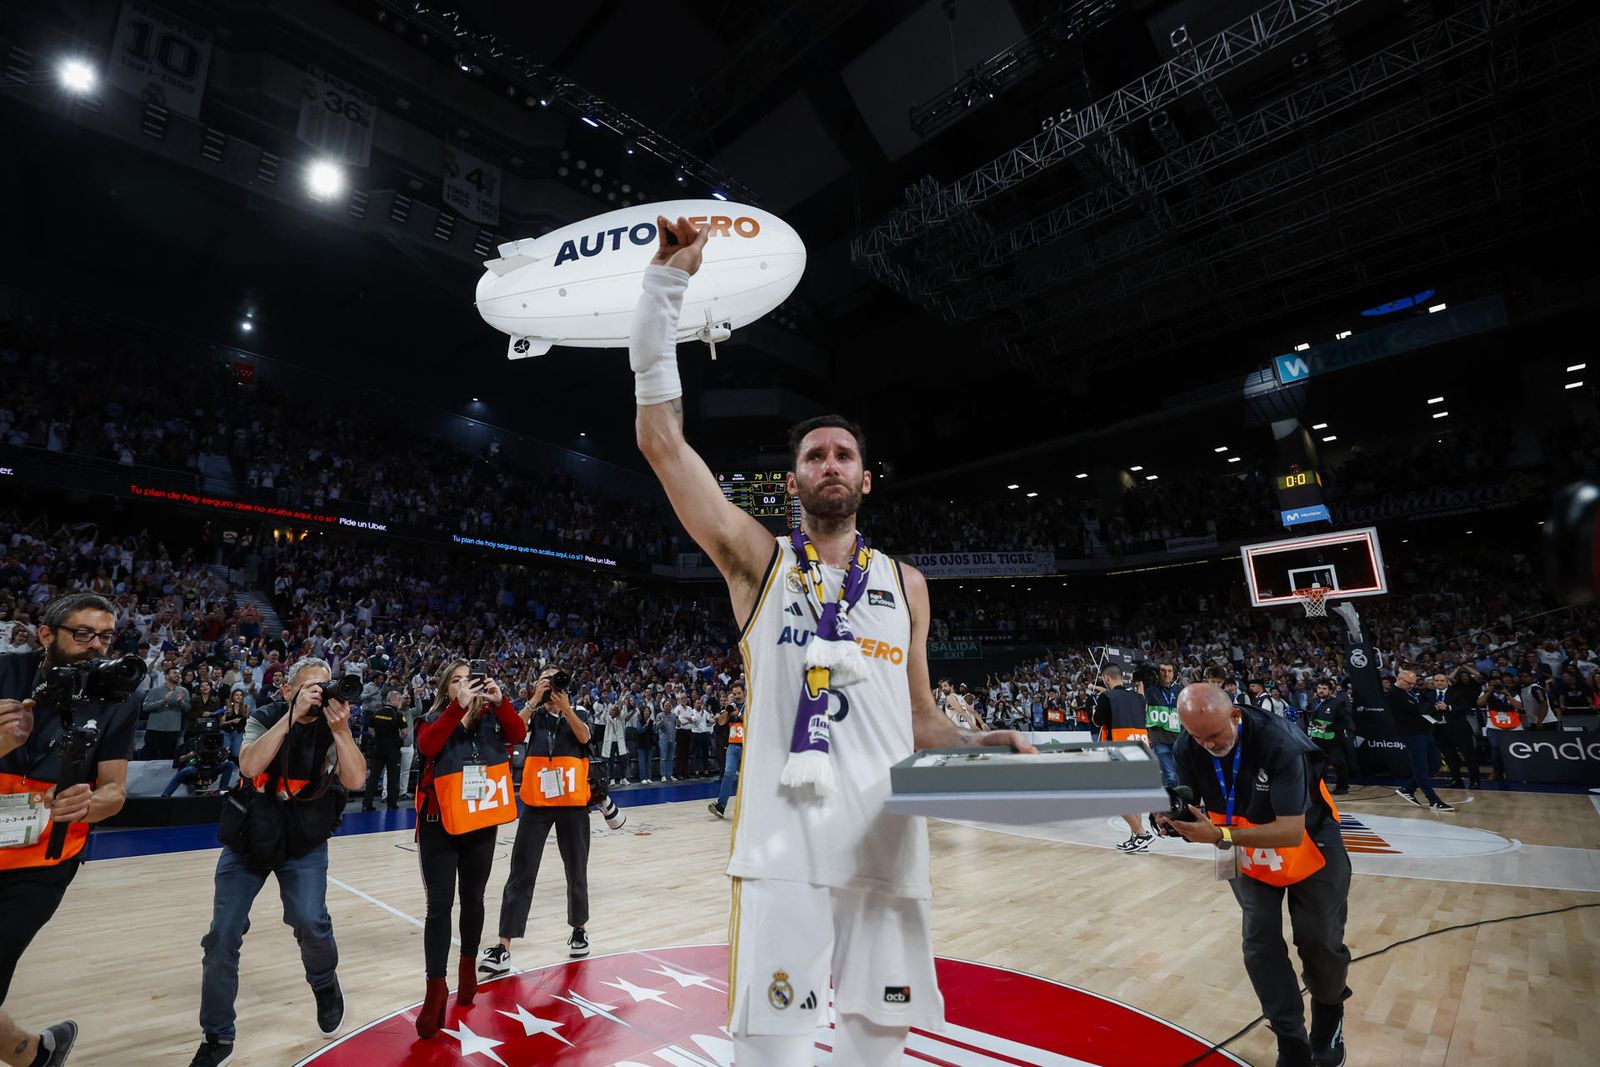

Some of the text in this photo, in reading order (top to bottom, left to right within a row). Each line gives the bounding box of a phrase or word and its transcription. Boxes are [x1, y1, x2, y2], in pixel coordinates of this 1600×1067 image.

[124, 20, 200, 81] 10
[323, 90, 362, 123] 36
[465, 168, 486, 192] 4
[554, 215, 760, 267] AUTOERO
[130, 485, 142, 495] Tu
[144, 487, 165, 498] plan
[168, 490, 181, 500] de
[182, 493, 200, 504] hoy
[235, 502, 253, 512] que
[254, 505, 266, 513] no
[339, 517, 357, 527] Pide
[357, 520, 368, 529] un
[452, 534, 460, 542] Tu
[461, 537, 475, 545] plan
[485, 540, 497, 549] hoy
[585, 555, 597, 563] Pide
[915, 553, 1035, 567] LOS OJOS DEL TIGRE
[930, 642, 978, 652] SALIDA
[944, 651, 965, 659] EXIT
[886, 992, 905, 1002] acb
